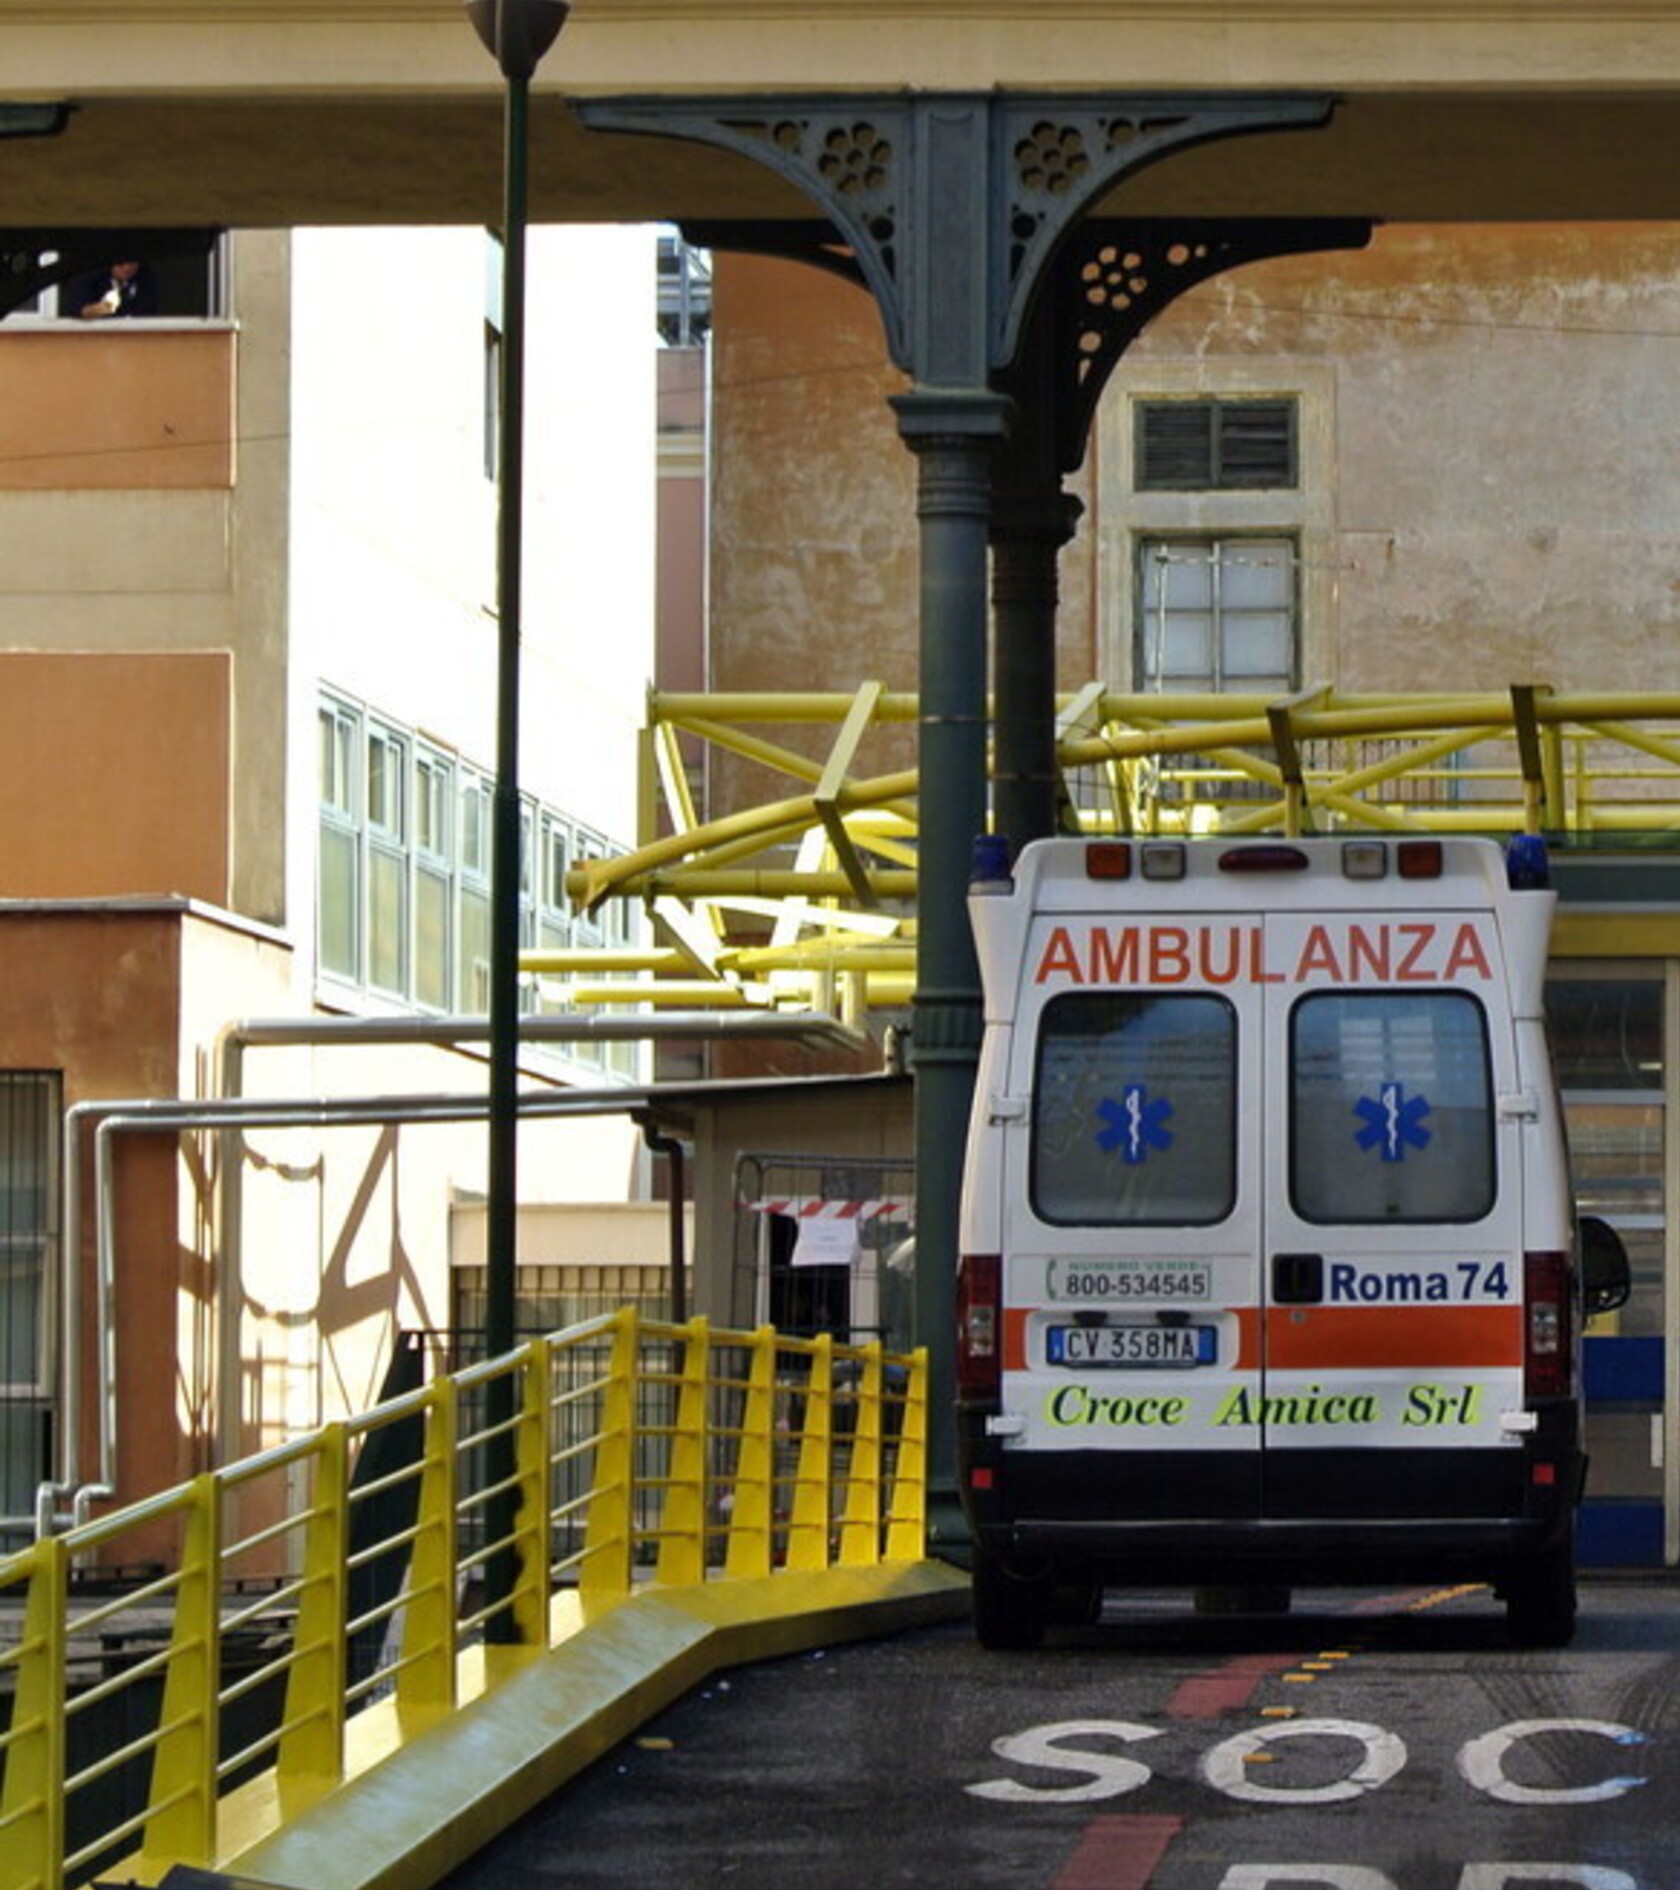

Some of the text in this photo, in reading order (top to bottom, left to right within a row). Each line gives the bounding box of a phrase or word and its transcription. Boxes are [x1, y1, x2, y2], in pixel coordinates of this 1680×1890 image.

[1035, 923, 1493, 985] AMBULANZA
[1066, 1273, 1206, 1295] 800-534545
[1330, 1260, 1509, 1302] Roma 74
[1067, 1330, 1195, 1359] CV 358MA
[1051, 1384, 1476, 1426] Croce Amica Srl
